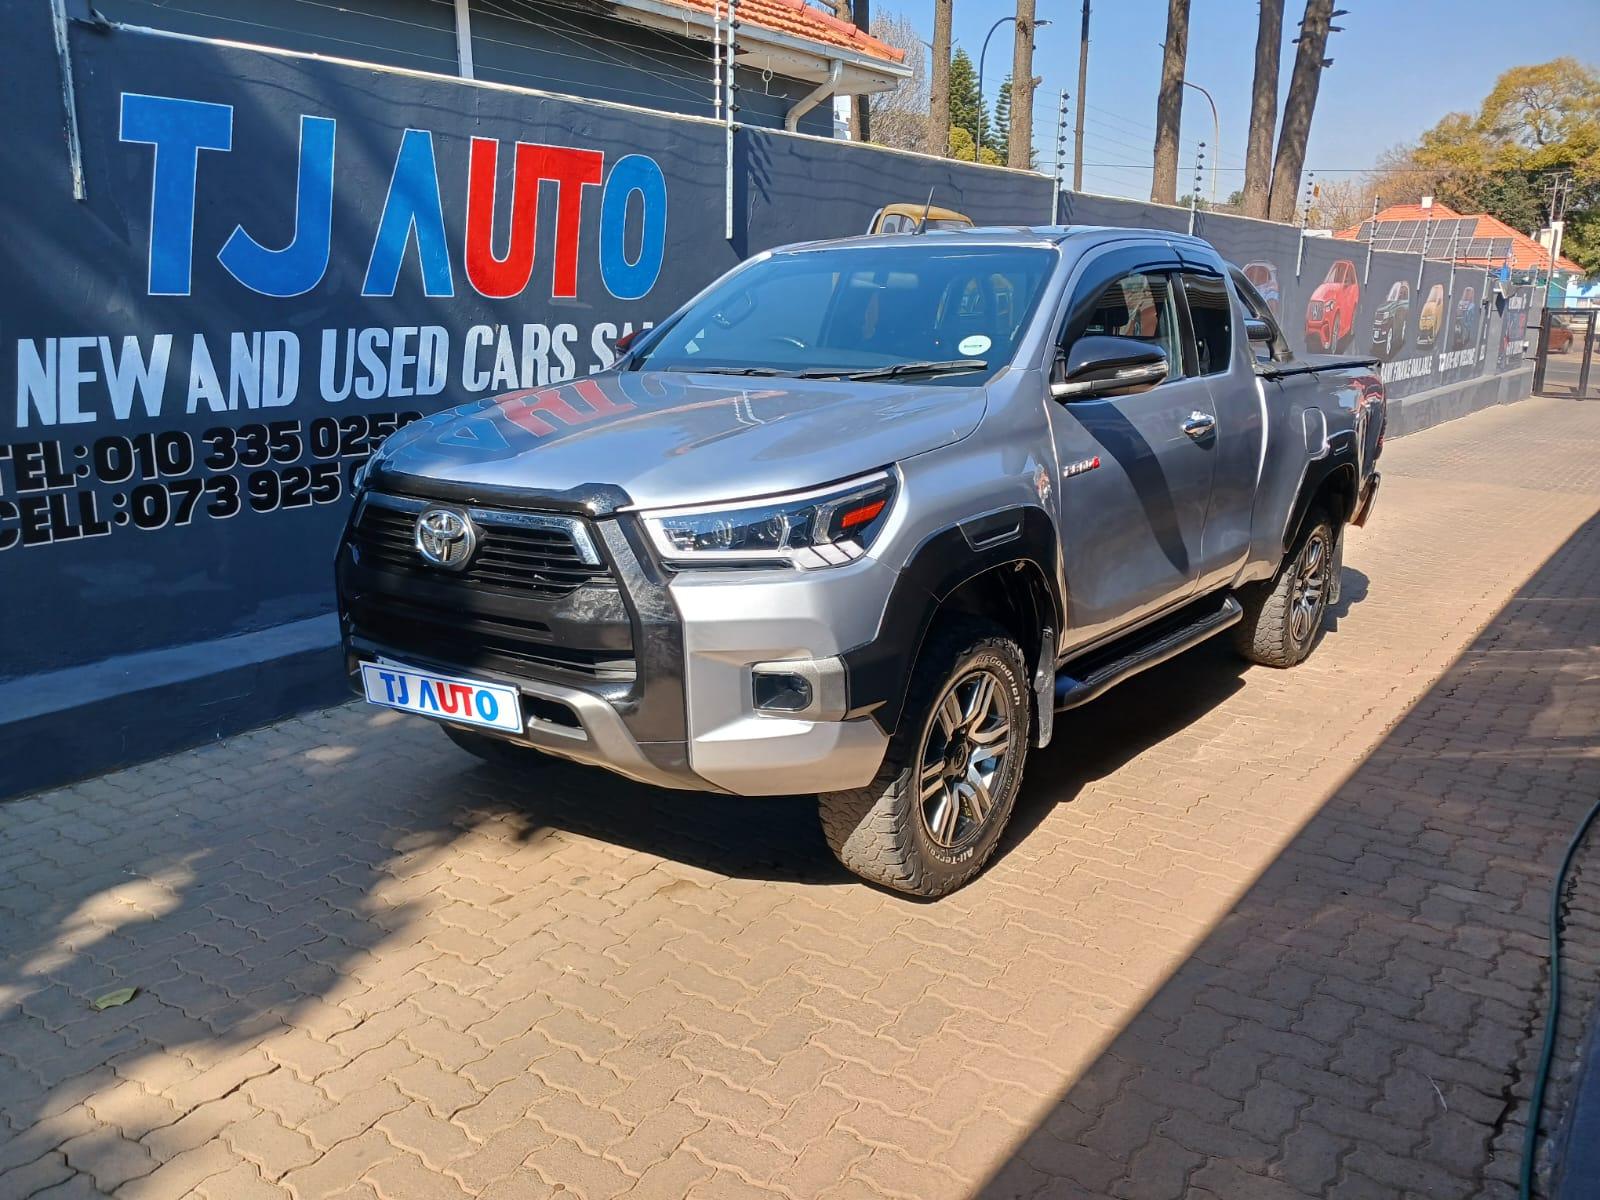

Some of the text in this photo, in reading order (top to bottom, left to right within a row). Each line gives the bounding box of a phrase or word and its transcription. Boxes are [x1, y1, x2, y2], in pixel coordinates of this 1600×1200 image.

[119, 92, 669, 301] TJ AUTO
[16, 333, 176, 428] NEW
[186, 330, 300, 414] AND
[319, 325, 451, 401] USED
[462, 323, 578, 392] CARS
[202, 420, 303, 472] 335
[248, 461, 342, 514] 925
[380, 671, 499, 721] TJ AUTO
